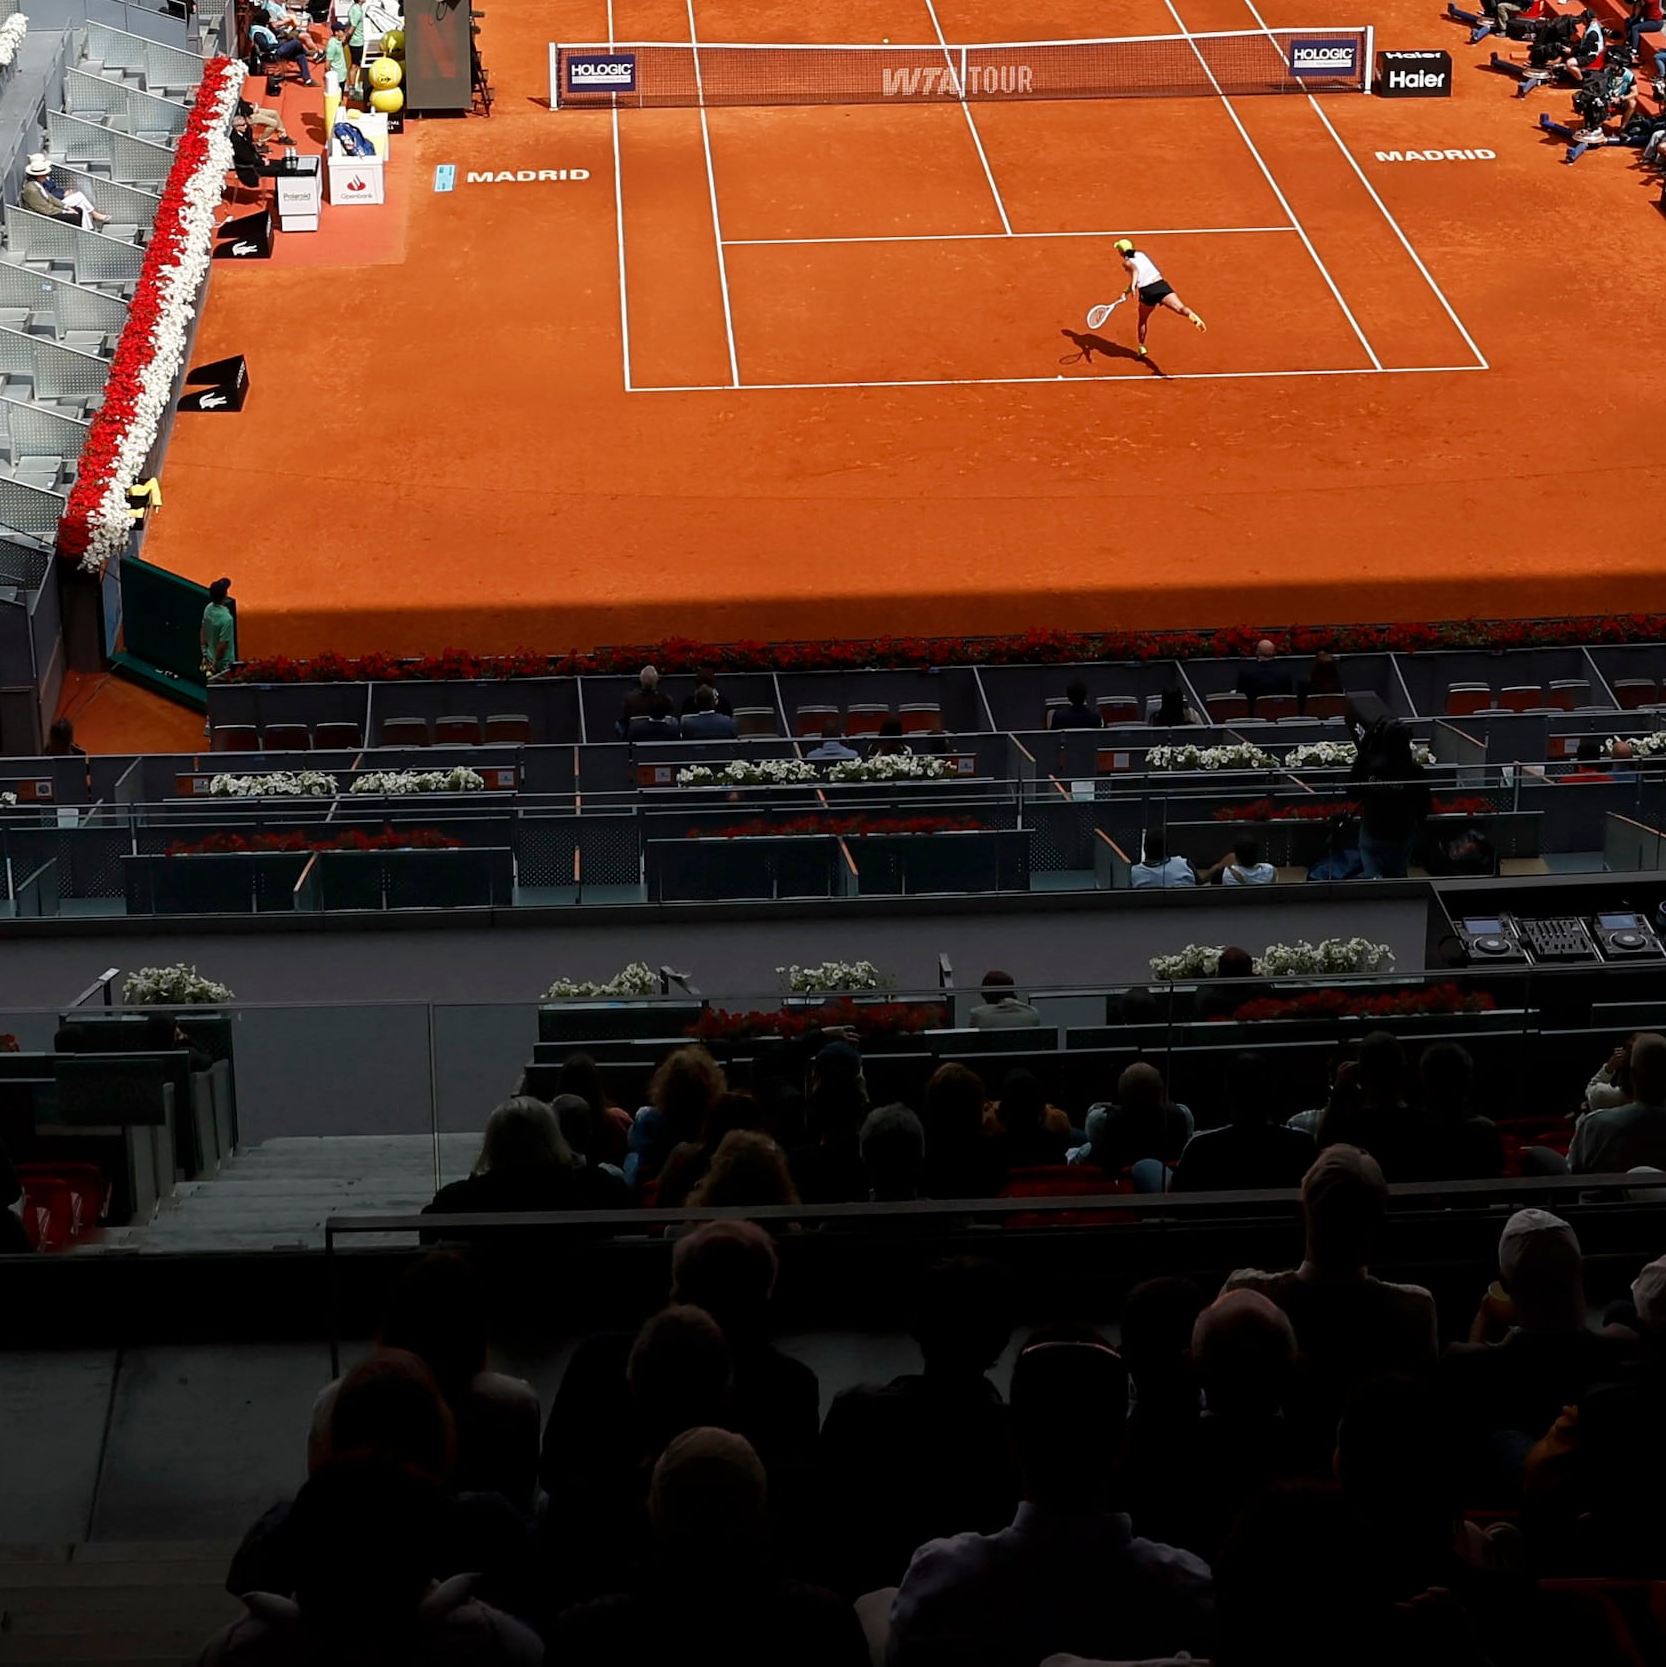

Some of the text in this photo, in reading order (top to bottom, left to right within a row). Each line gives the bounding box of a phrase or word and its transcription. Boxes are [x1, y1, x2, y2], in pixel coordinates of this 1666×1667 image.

[1293, 48, 1354, 60] HOLOGIC
[571, 63, 632, 76] HOLOGIC
[883, 65, 1033, 95] WTA TOUR
[1389, 69, 1445, 88] Haier
[1374, 149, 1497, 162] MADRID
[467, 169, 590, 183] MADRID
[283, 192, 310, 201] Polaroid
[340, 192, 373, 200] Openbank
